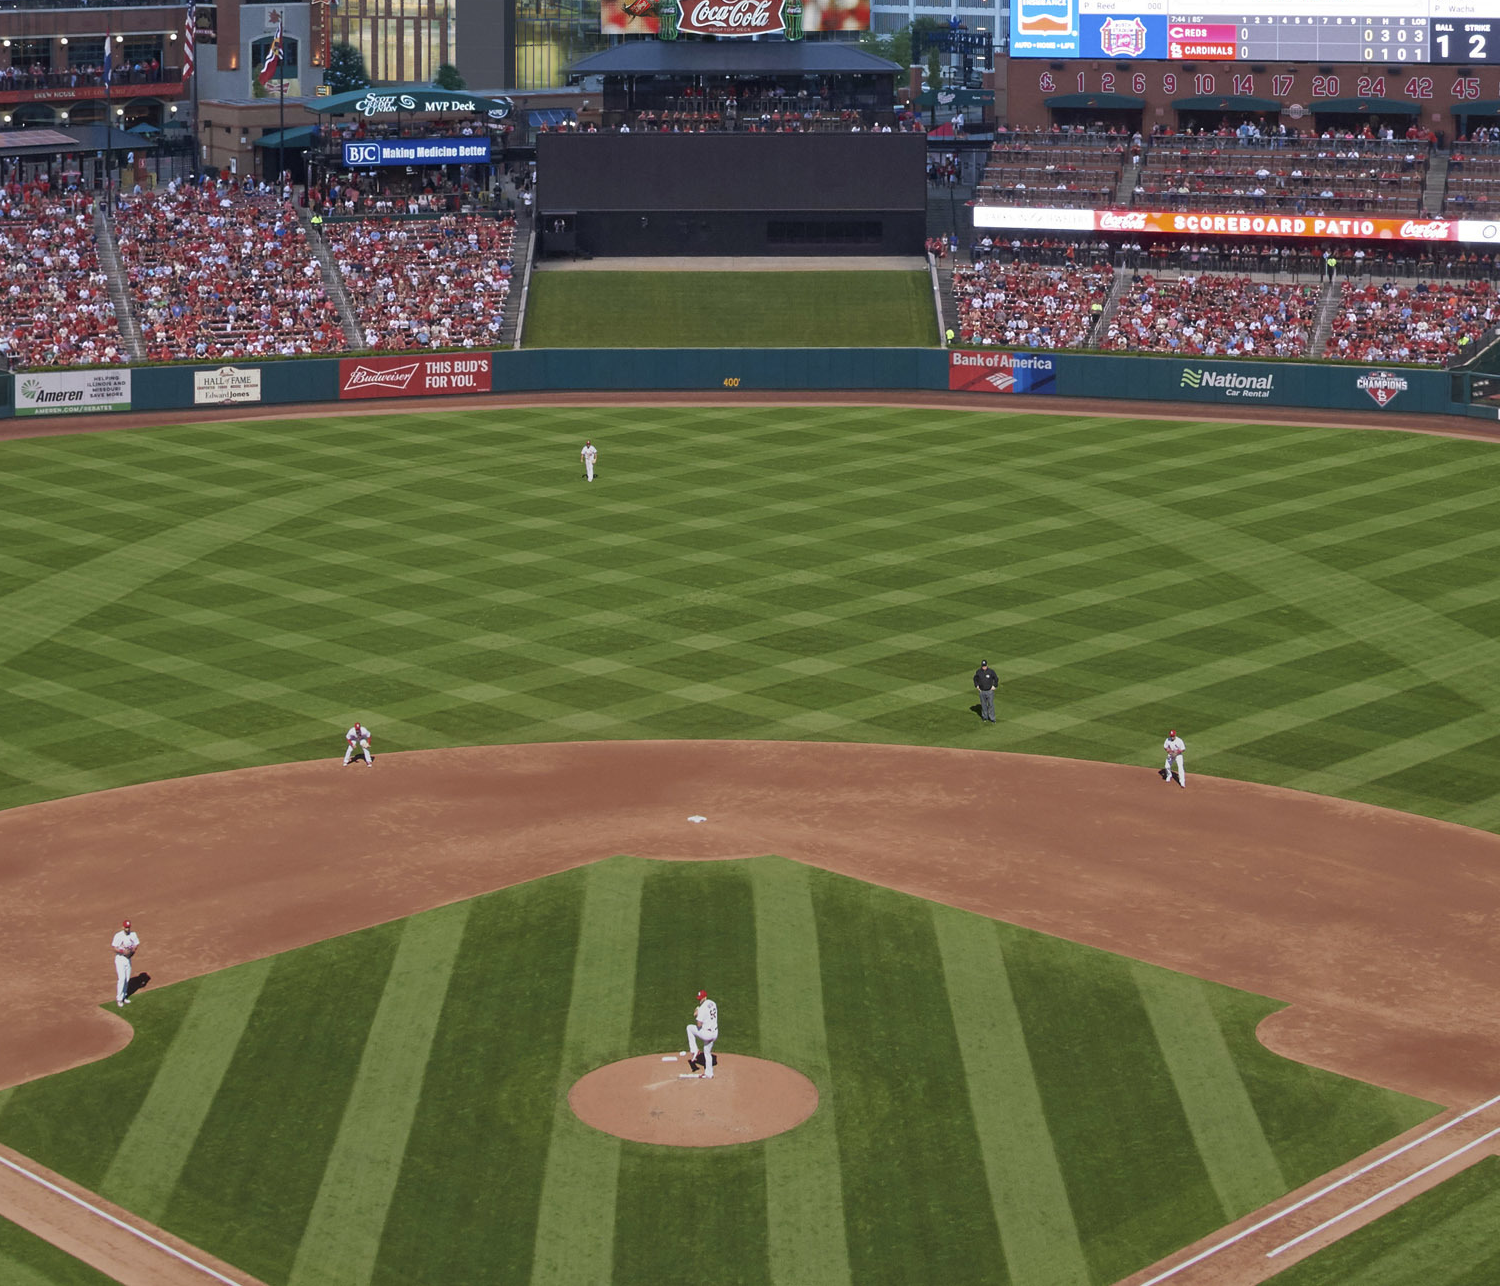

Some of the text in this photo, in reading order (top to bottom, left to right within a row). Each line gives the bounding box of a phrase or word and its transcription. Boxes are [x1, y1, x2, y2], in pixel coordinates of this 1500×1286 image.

[691, 0, 772, 27] Coca-Cola
[1184, 28, 1208, 37] REDS
[1464, 24, 1491, 32] STRIKE
[1184, 46, 1233, 56] CARDINALS
[1437, 35, 1449, 58] 1
[1468, 35, 1486, 58] 2
[1272, 74, 1294, 95] 17
[1312, 75, 1340, 96] 20
[1357, 76, 1386, 97] 24
[1404, 77, 1434, 98] 42
[1450, 78, 1481, 99] 45
[366, 93, 397, 103] SCOTT
[425, 100, 475, 111] MVP Deck
[349, 145, 487, 162] BJC Making Medicine Better
[1100, 212, 1148, 230] Coca-Cola
[1174, 216, 1306, 233] SCOREBOARD
[1314, 219, 1374, 235] PATIO
[1400, 221, 1450, 239] Coca-Cola
[426, 360, 488, 374] THIS BUD'S
[952, 353, 1052, 370] Bank of America
[204, 377, 224, 386] HALL
[231, 376, 251, 385] FAME
[350, 371, 411, 384] Budweiser
[426, 375, 477, 388] FOR YOU.
[722, 377, 741, 388] 400'
[1357, 379, 1408, 391] CHAMPIONS
[36, 389, 83, 403] Ameren
[229, 390, 250, 398] Jones
[1226, 389, 1269, 398] Car Rental
